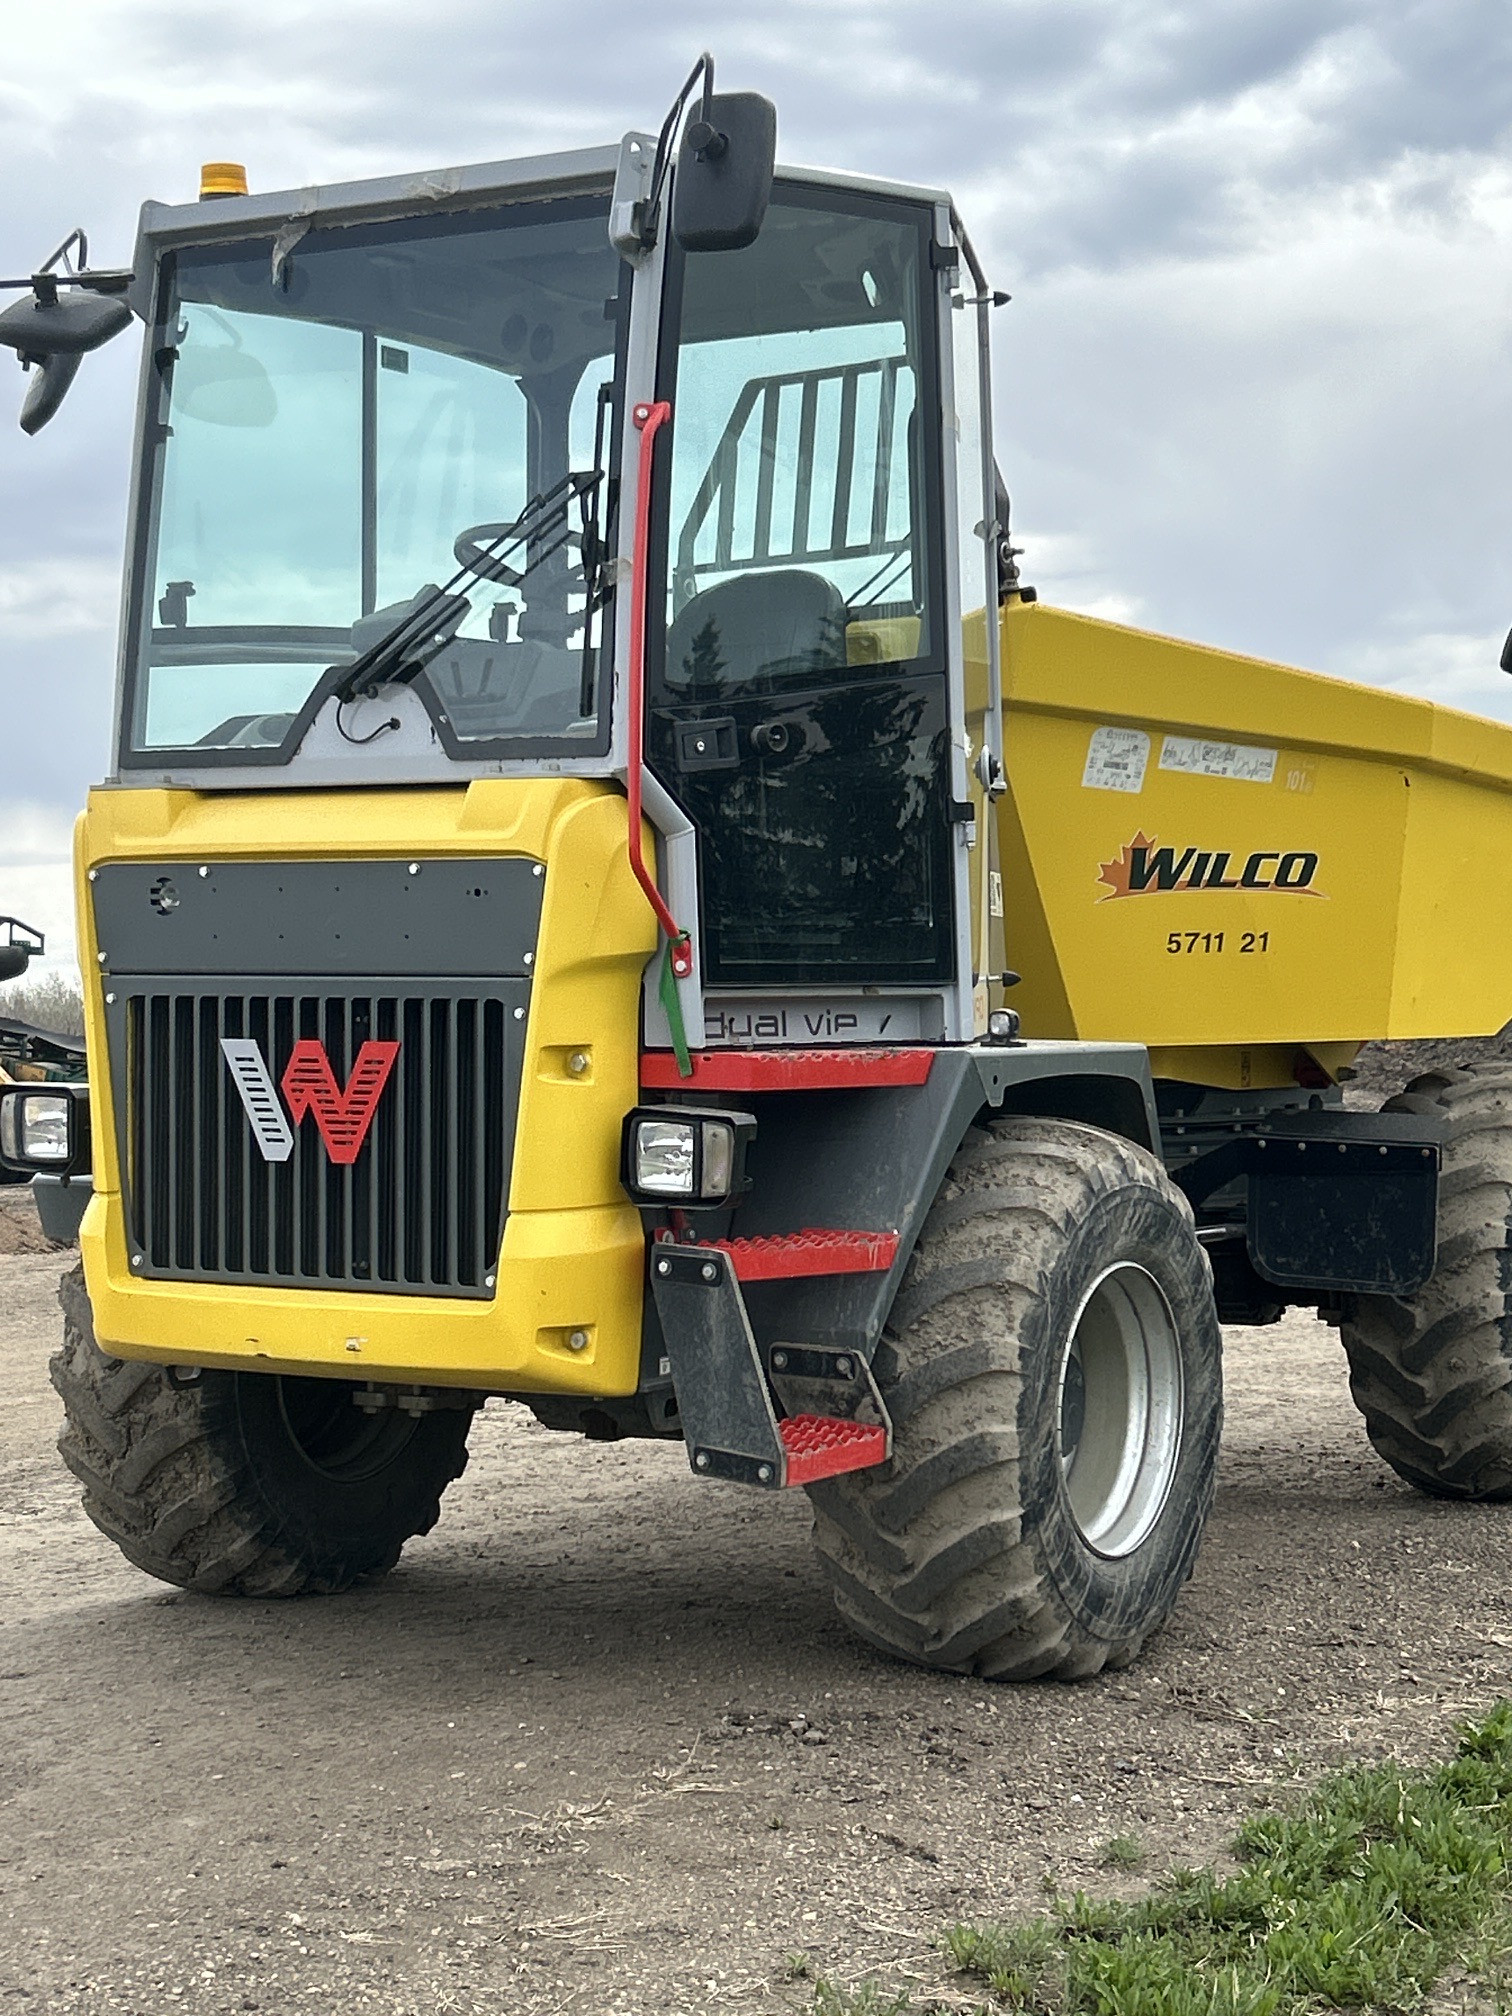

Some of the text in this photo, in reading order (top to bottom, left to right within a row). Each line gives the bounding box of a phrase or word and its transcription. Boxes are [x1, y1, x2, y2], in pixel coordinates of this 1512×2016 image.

[1128, 847, 1319, 891] WILCO
[1166, 930, 1270, 954] 5711 21
[704, 1009, 788, 1040] dual
